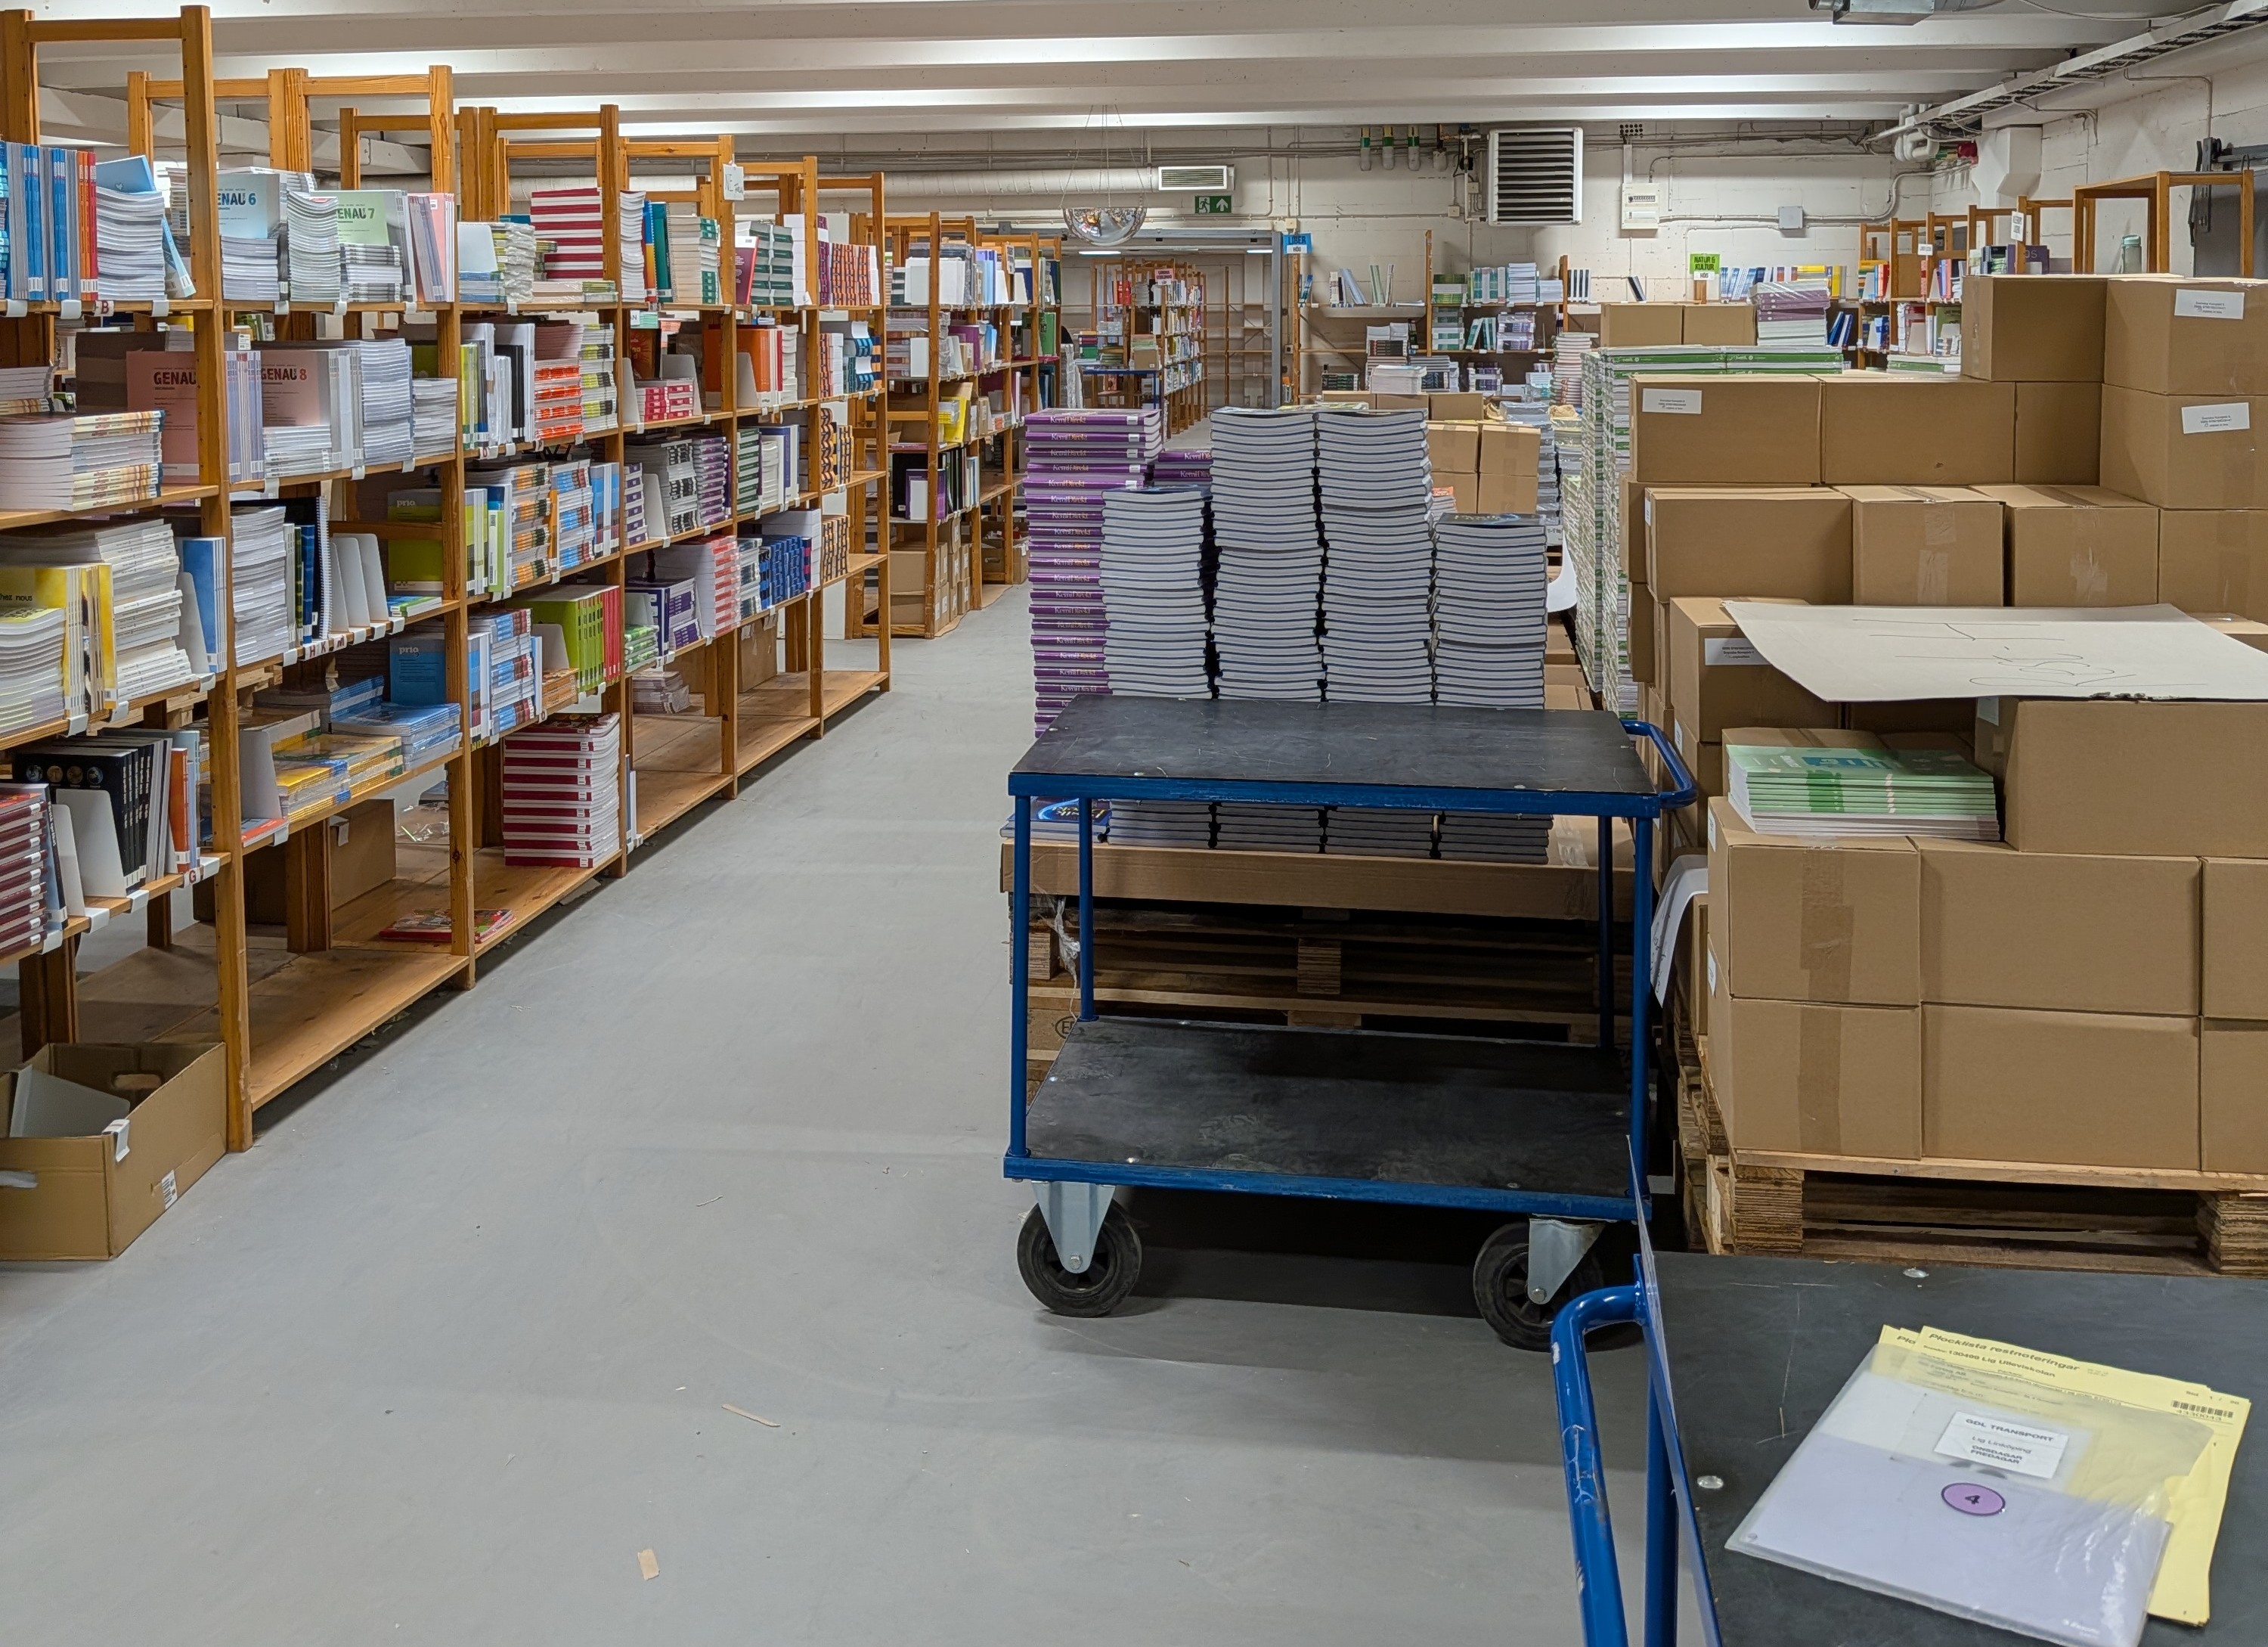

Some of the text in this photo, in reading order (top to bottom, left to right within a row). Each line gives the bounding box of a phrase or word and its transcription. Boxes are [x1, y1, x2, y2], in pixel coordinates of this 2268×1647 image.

[218, 192, 256, 206] ENAU 6
[337, 207, 375, 219] ENAU 7
[1287, 235, 1306, 245] LIBER
[101, 302, 110, 315] B
[153, 371, 197, 385] GENAU
[261, 368, 308, 380] GENAU 8
[396, 499, 416, 507] prio
[309, 640, 326, 658] H K
[398, 647, 420, 655] prio
[189, 870, 197, 884] G
[1896, 1335, 1916, 1345] Plo
[1929, 1332, 2080, 1372] Plocklista restnoteringar
[1981, 1356, 1997, 1365] Lig
[1998, 1360, 2056, 1379] Ulleviskolan
[1966, 1418, 2055, 1443] GDL TRANSPORT
[1972, 1435, 2033, 1454] Lig Linköping
[1970, 1449, 2021, 1465] FREDAGAR
[1972, 1444, 2023, 1461] ONSDAGAR
[1964, 1494, 1981, 1505] 4
